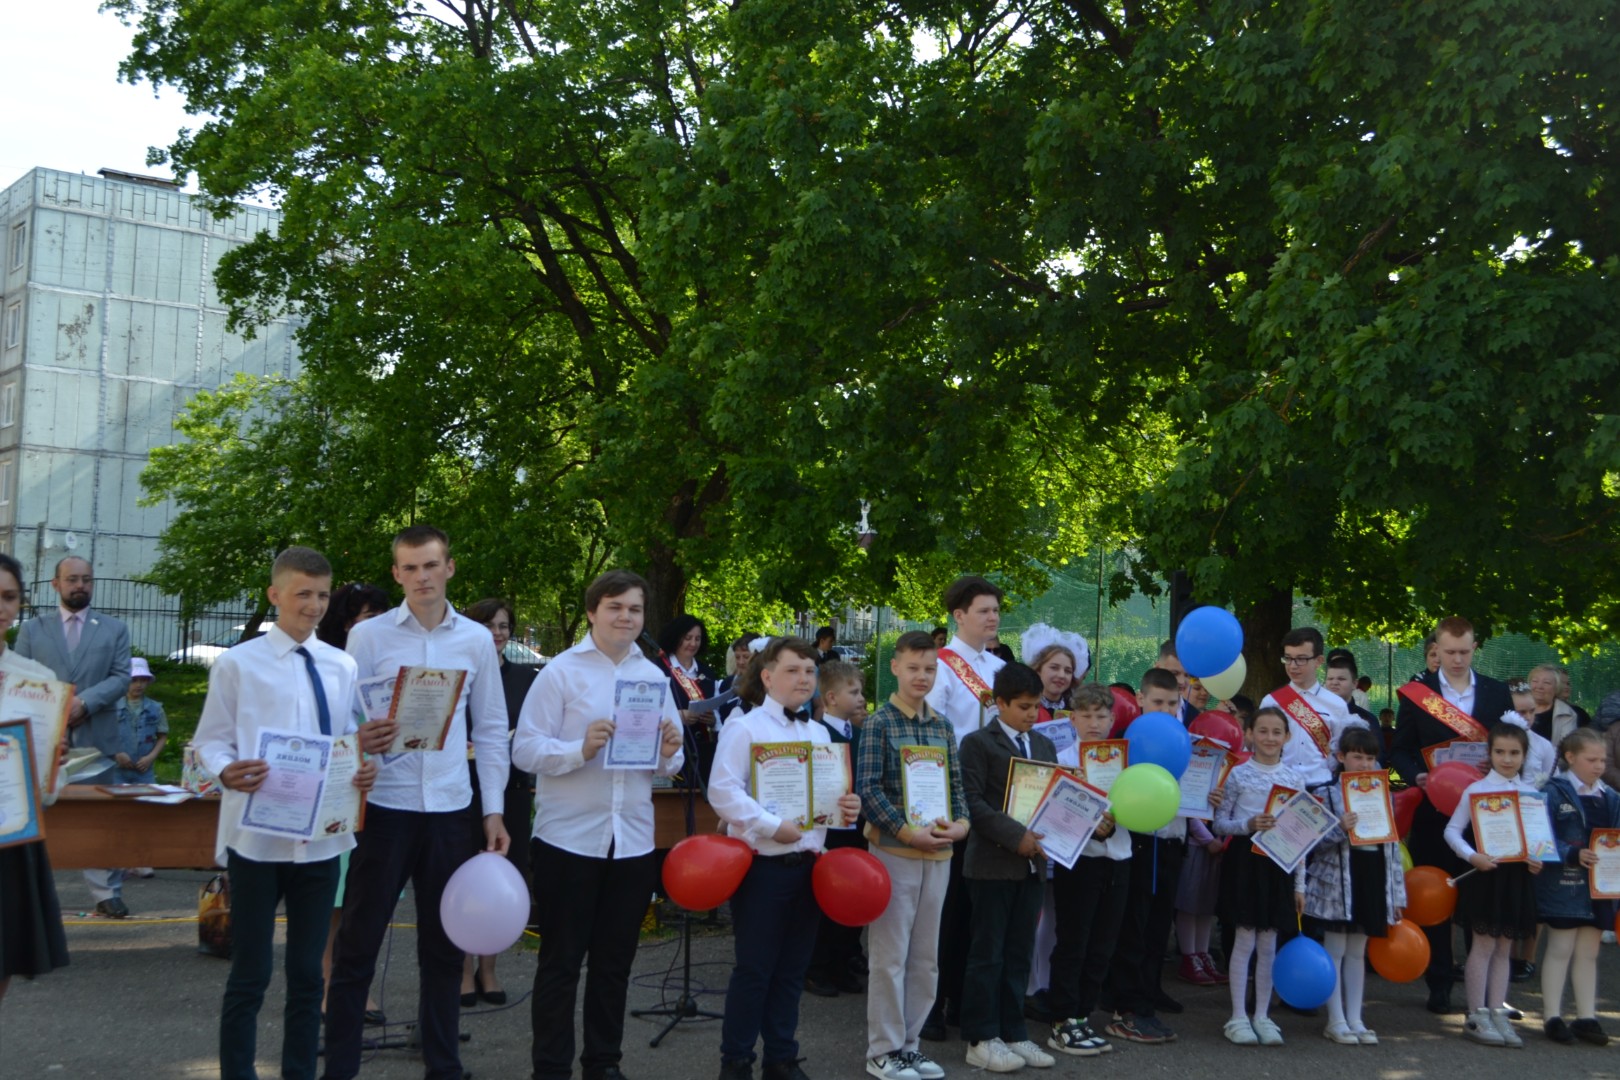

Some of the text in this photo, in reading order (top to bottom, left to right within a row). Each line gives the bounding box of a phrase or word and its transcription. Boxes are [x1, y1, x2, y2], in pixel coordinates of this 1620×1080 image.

[411, 679, 450, 687] ГРАМОТА
[9, 686, 56, 704] ГРАМОТА
[275, 753, 311, 763] ДИПЛОМ
